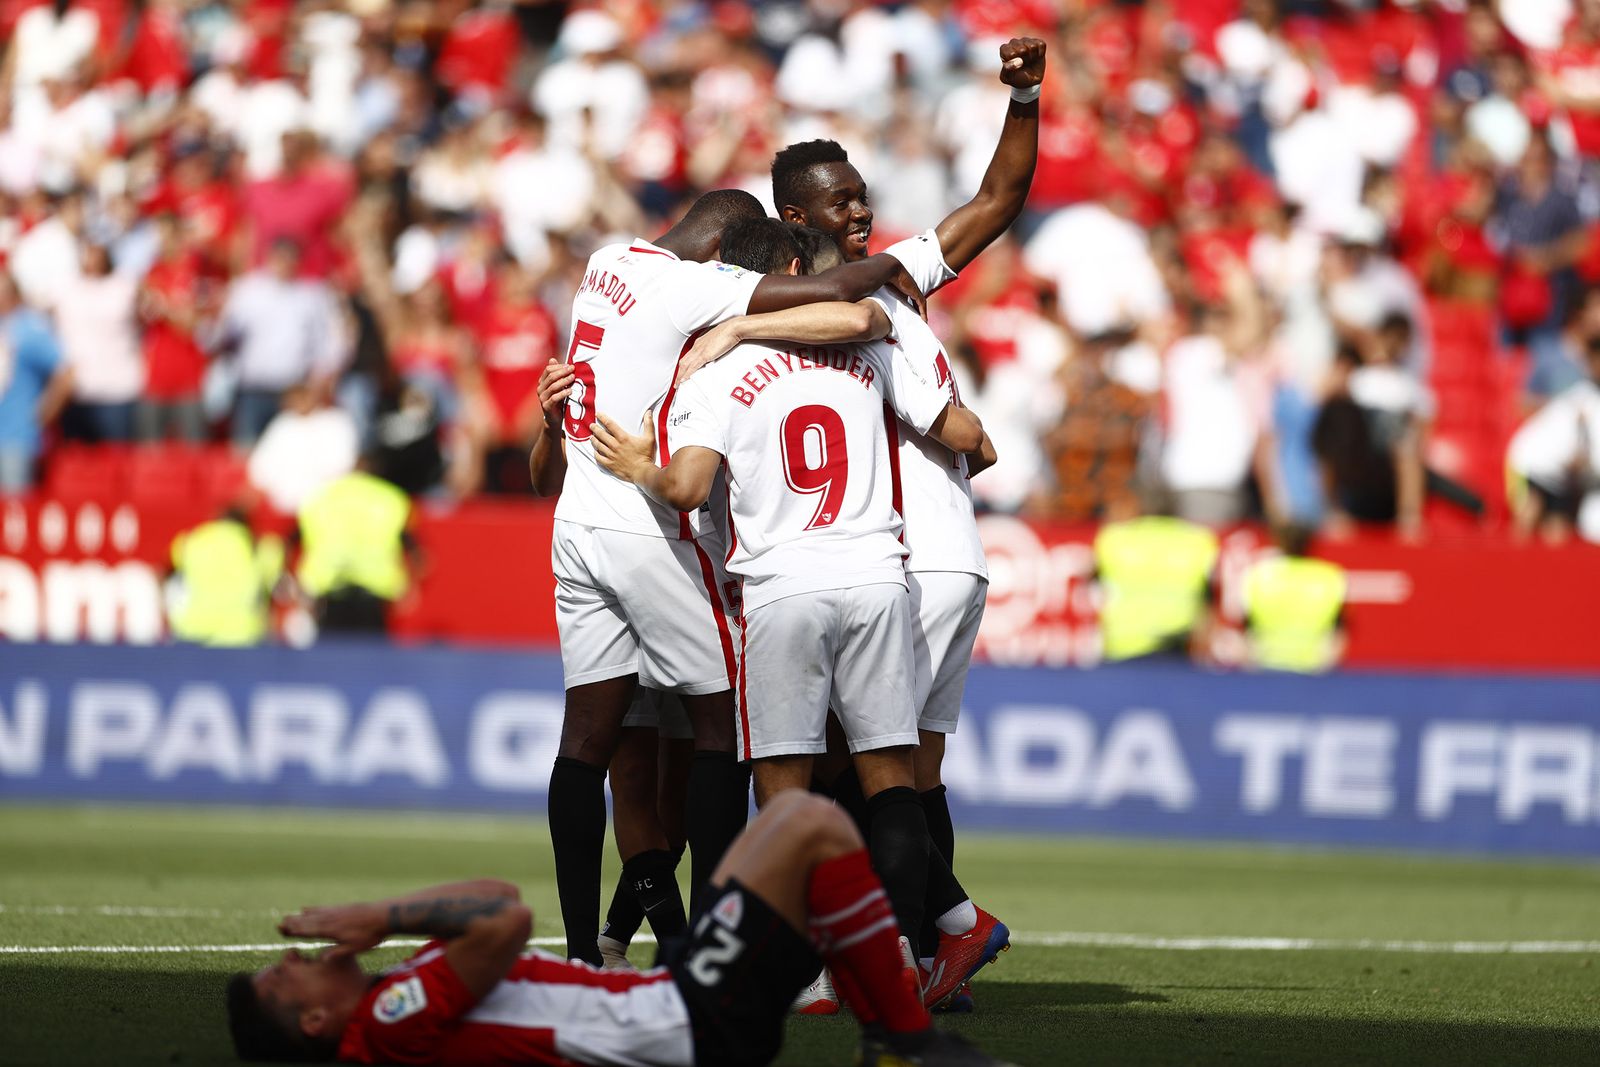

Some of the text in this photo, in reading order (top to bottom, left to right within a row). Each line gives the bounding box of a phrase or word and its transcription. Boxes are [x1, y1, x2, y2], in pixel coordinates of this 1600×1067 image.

[564, 319, 605, 442] 5
[779, 404, 848, 531] 9
[67, 682, 451, 788] PARA
[1216, 714, 1396, 818] TE
[1417, 719, 1600, 826] FR
